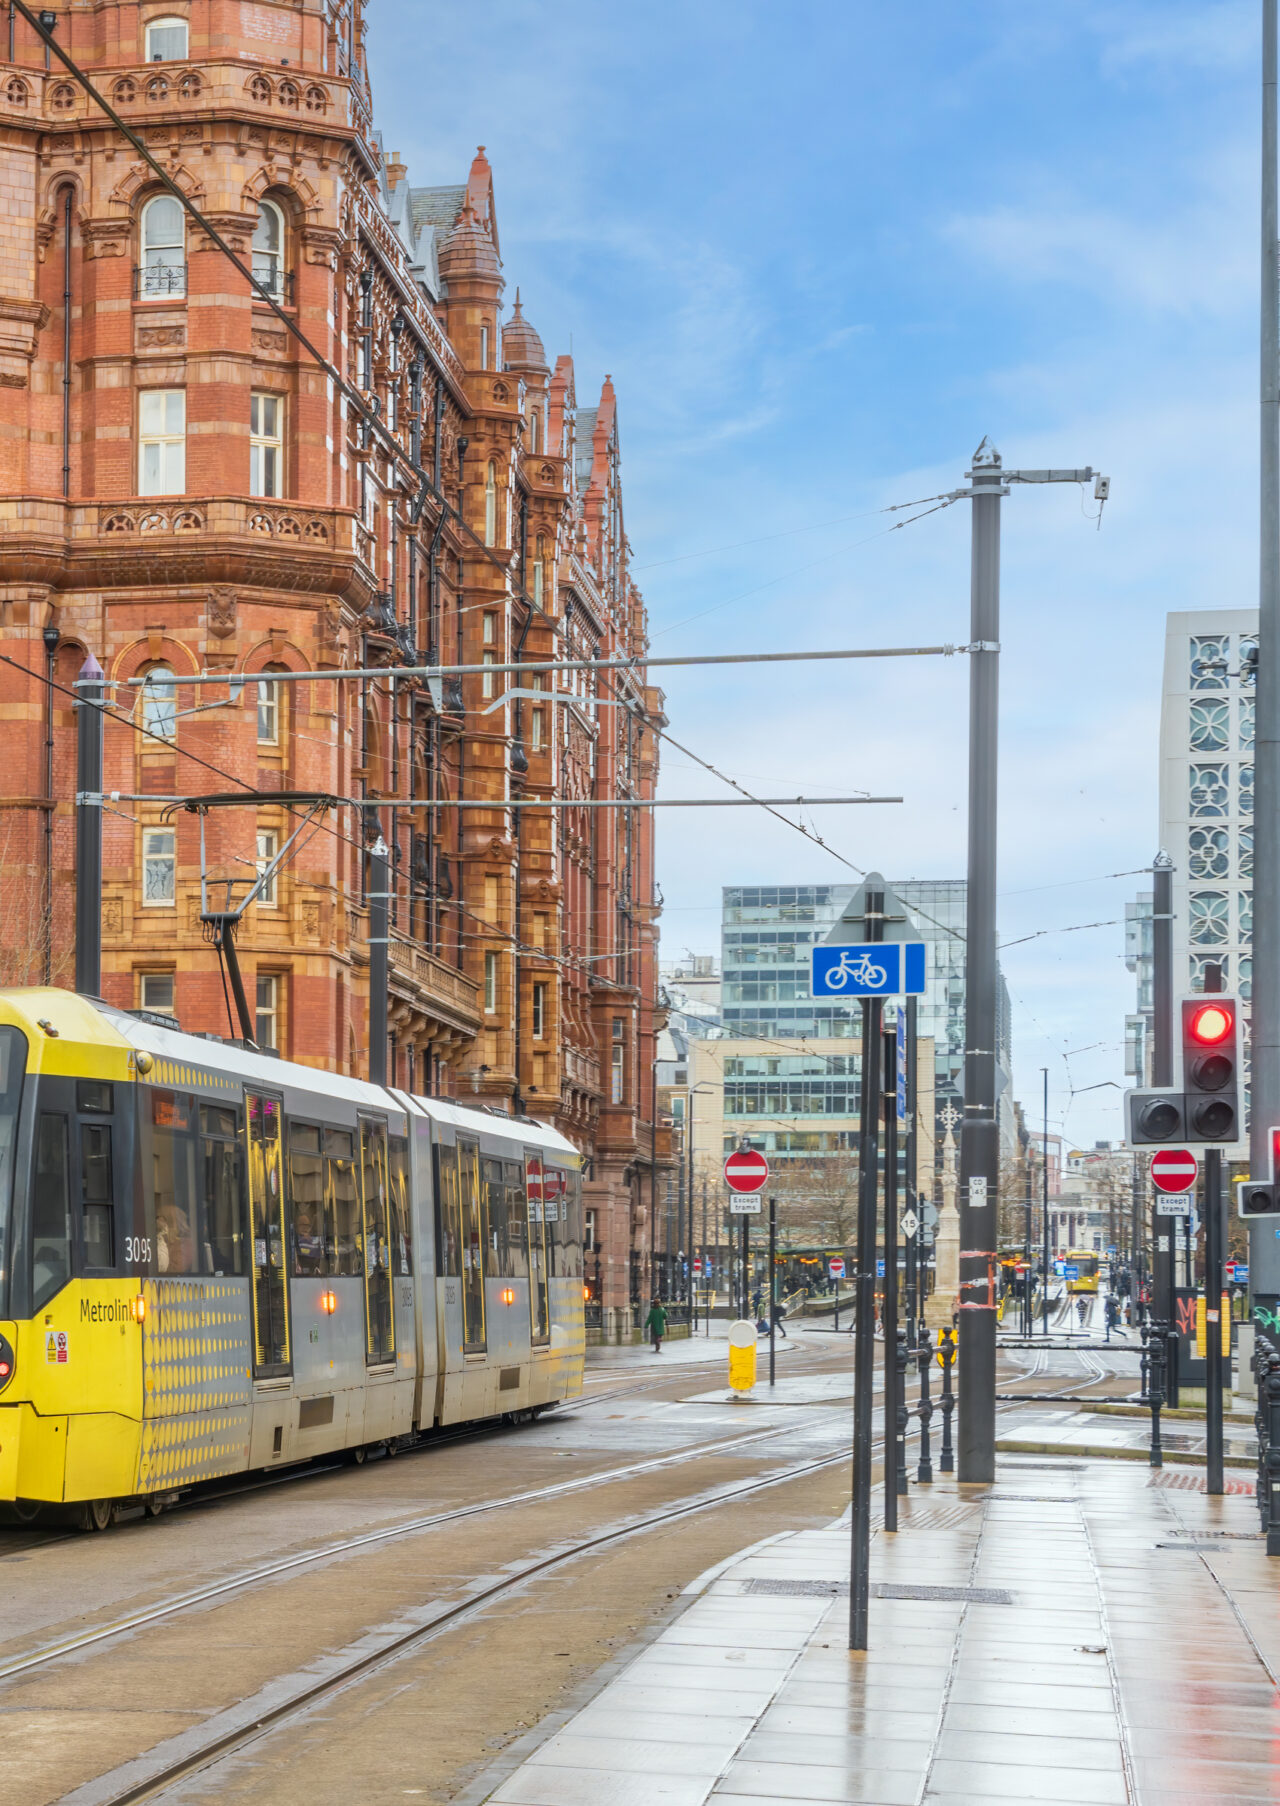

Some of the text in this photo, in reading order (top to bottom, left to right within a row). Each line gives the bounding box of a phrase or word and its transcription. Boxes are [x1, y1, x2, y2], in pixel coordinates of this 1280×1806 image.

[733, 1196, 759, 1204] Except
[1160, 1196, 1187, 1206] Except
[904, 1219, 916, 1228] 15
[124, 1236, 152, 1263] 3095
[80, 1298, 135, 1323] Metrolink
